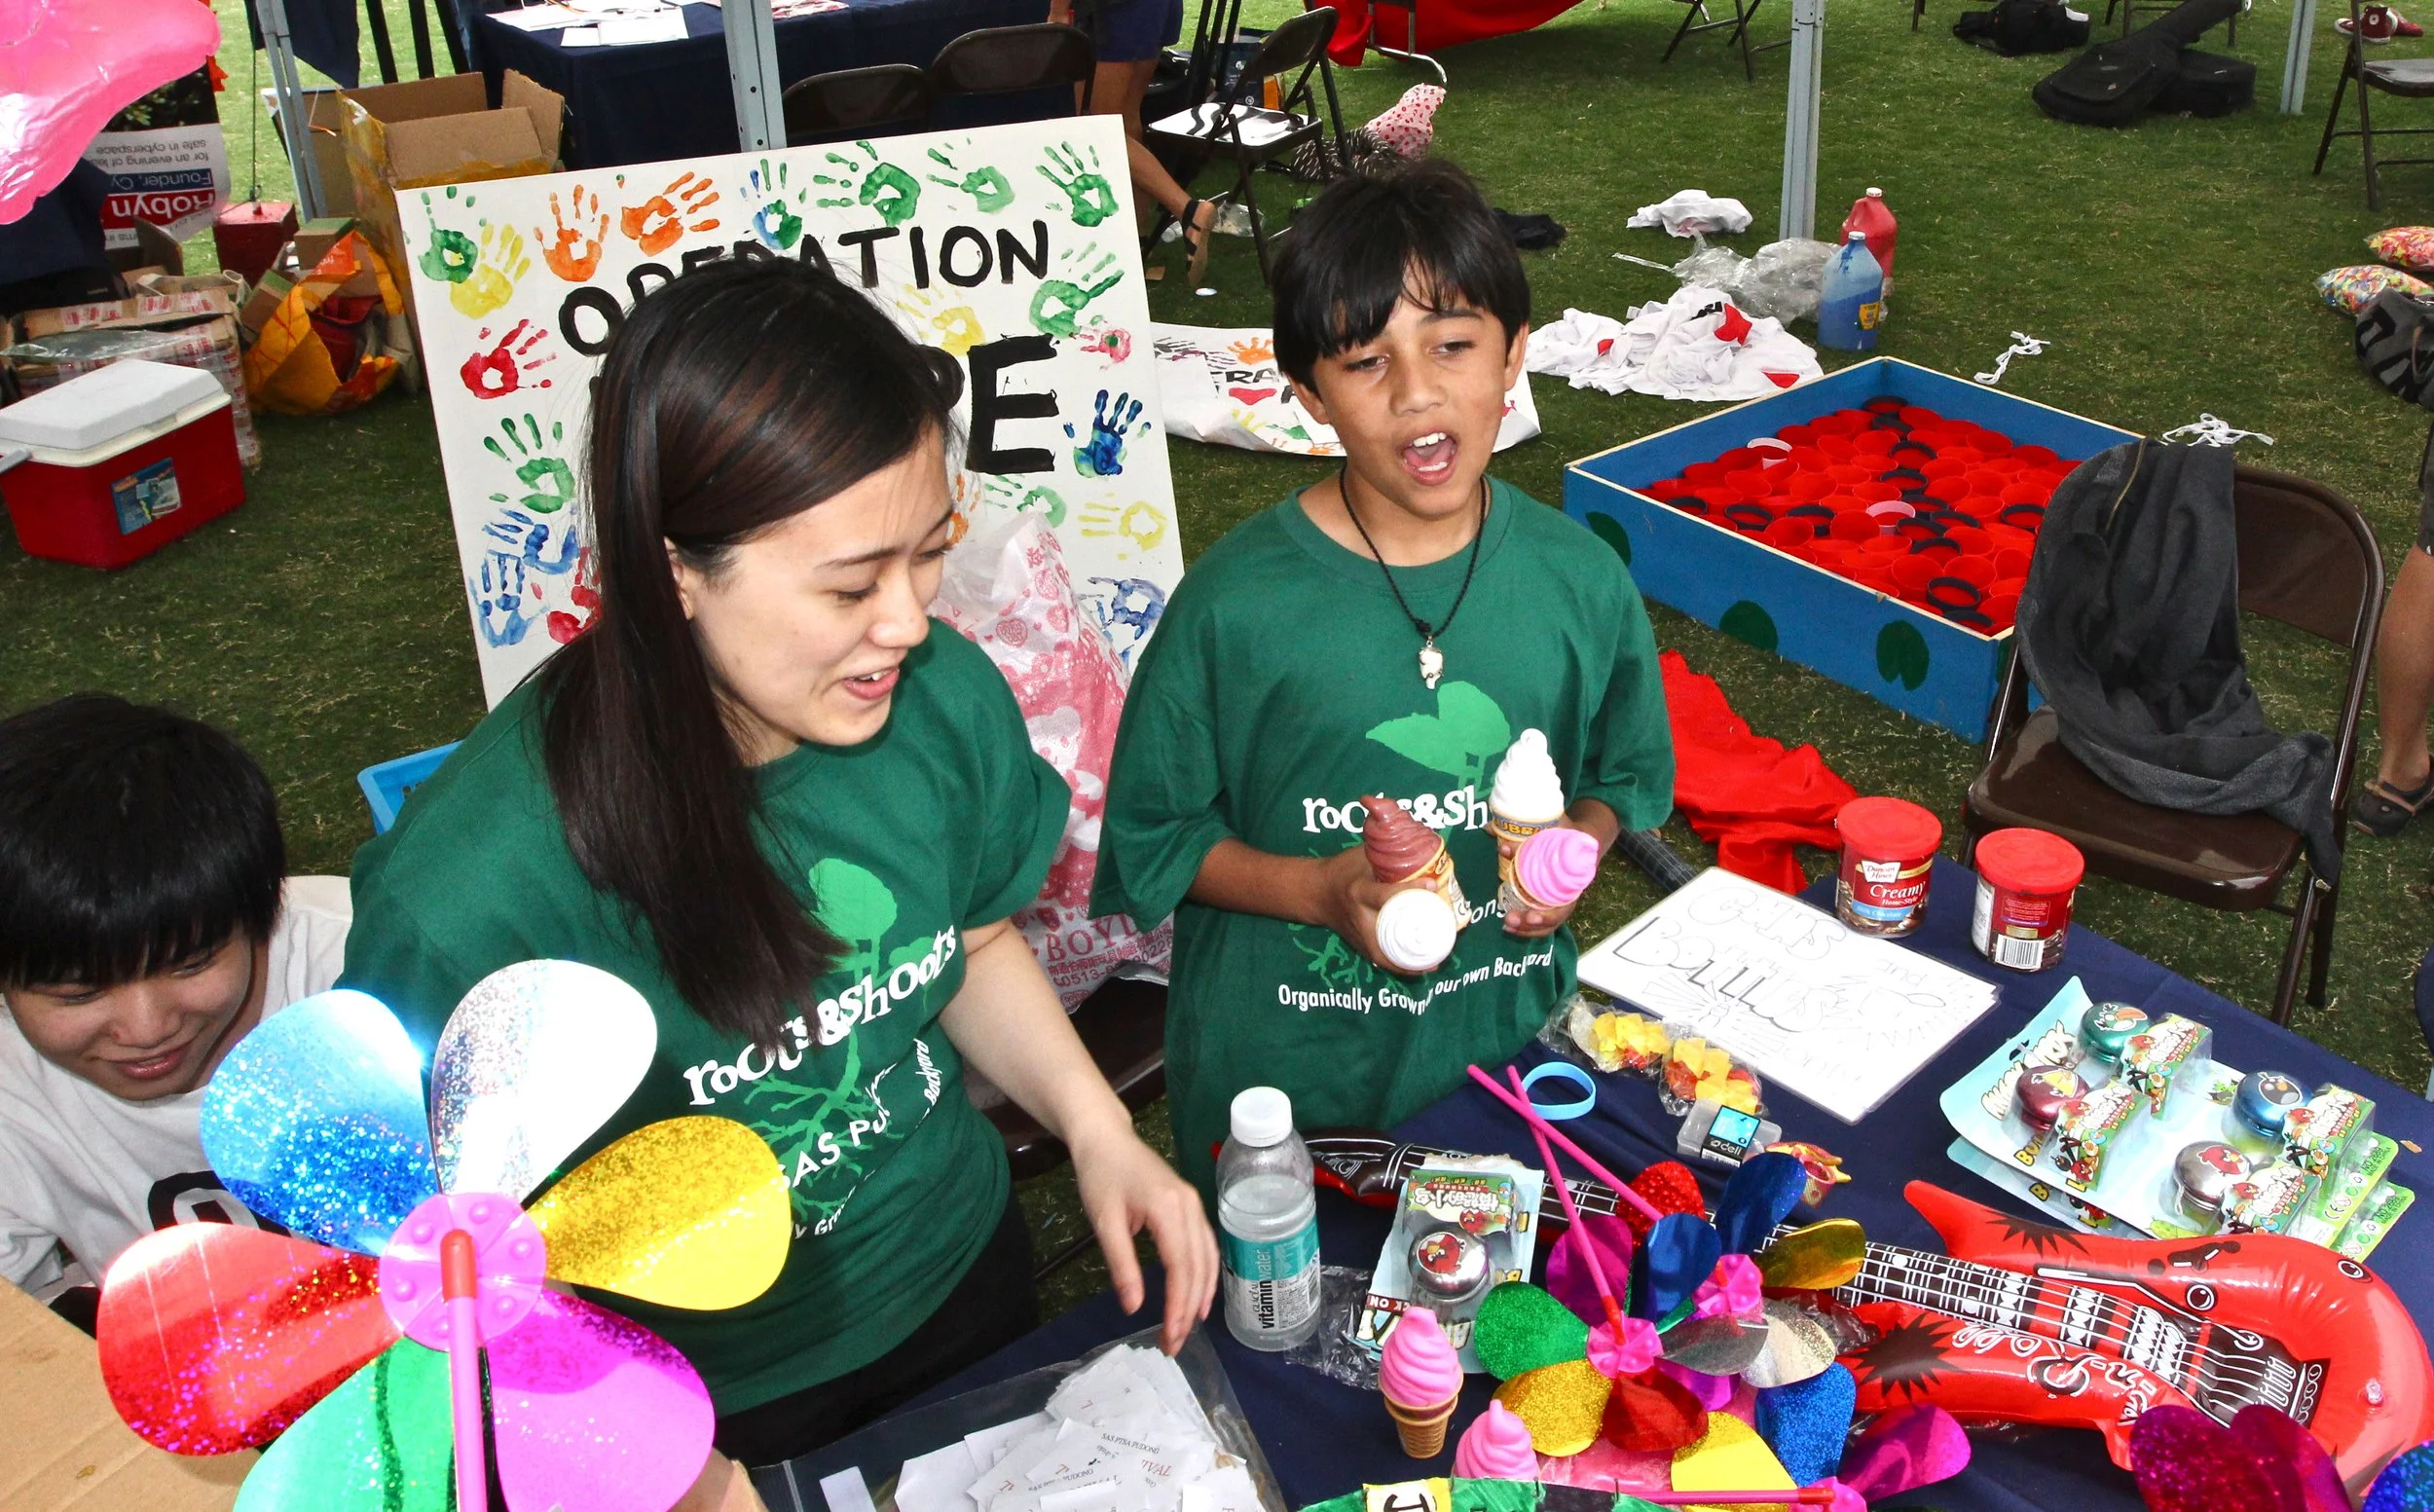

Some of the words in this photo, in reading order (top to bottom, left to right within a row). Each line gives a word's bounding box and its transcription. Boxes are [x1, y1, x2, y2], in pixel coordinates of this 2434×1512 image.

[95, 142, 166, 155] cyberspace
[182, 138, 206, 148] safe
[111, 158, 124, 167] of
[126, 156, 172, 167] evening
[174, 154, 192, 163] an
[195, 152, 209, 163] for
[139, 170, 212, 186] Founder,
[111, 194, 214, 218] Robyn
[558, 220, 1049, 357] OPTION
[1869, 880, 1926, 899] Creamy
[1277, 984, 1373, 1014] Organically
[1378, 988, 1425, 1015] Grown
[1434, 979, 1461, 995] our
[1462, 967, 1490, 986] own
[1131, 1440, 1161, 1455] PUDONG
